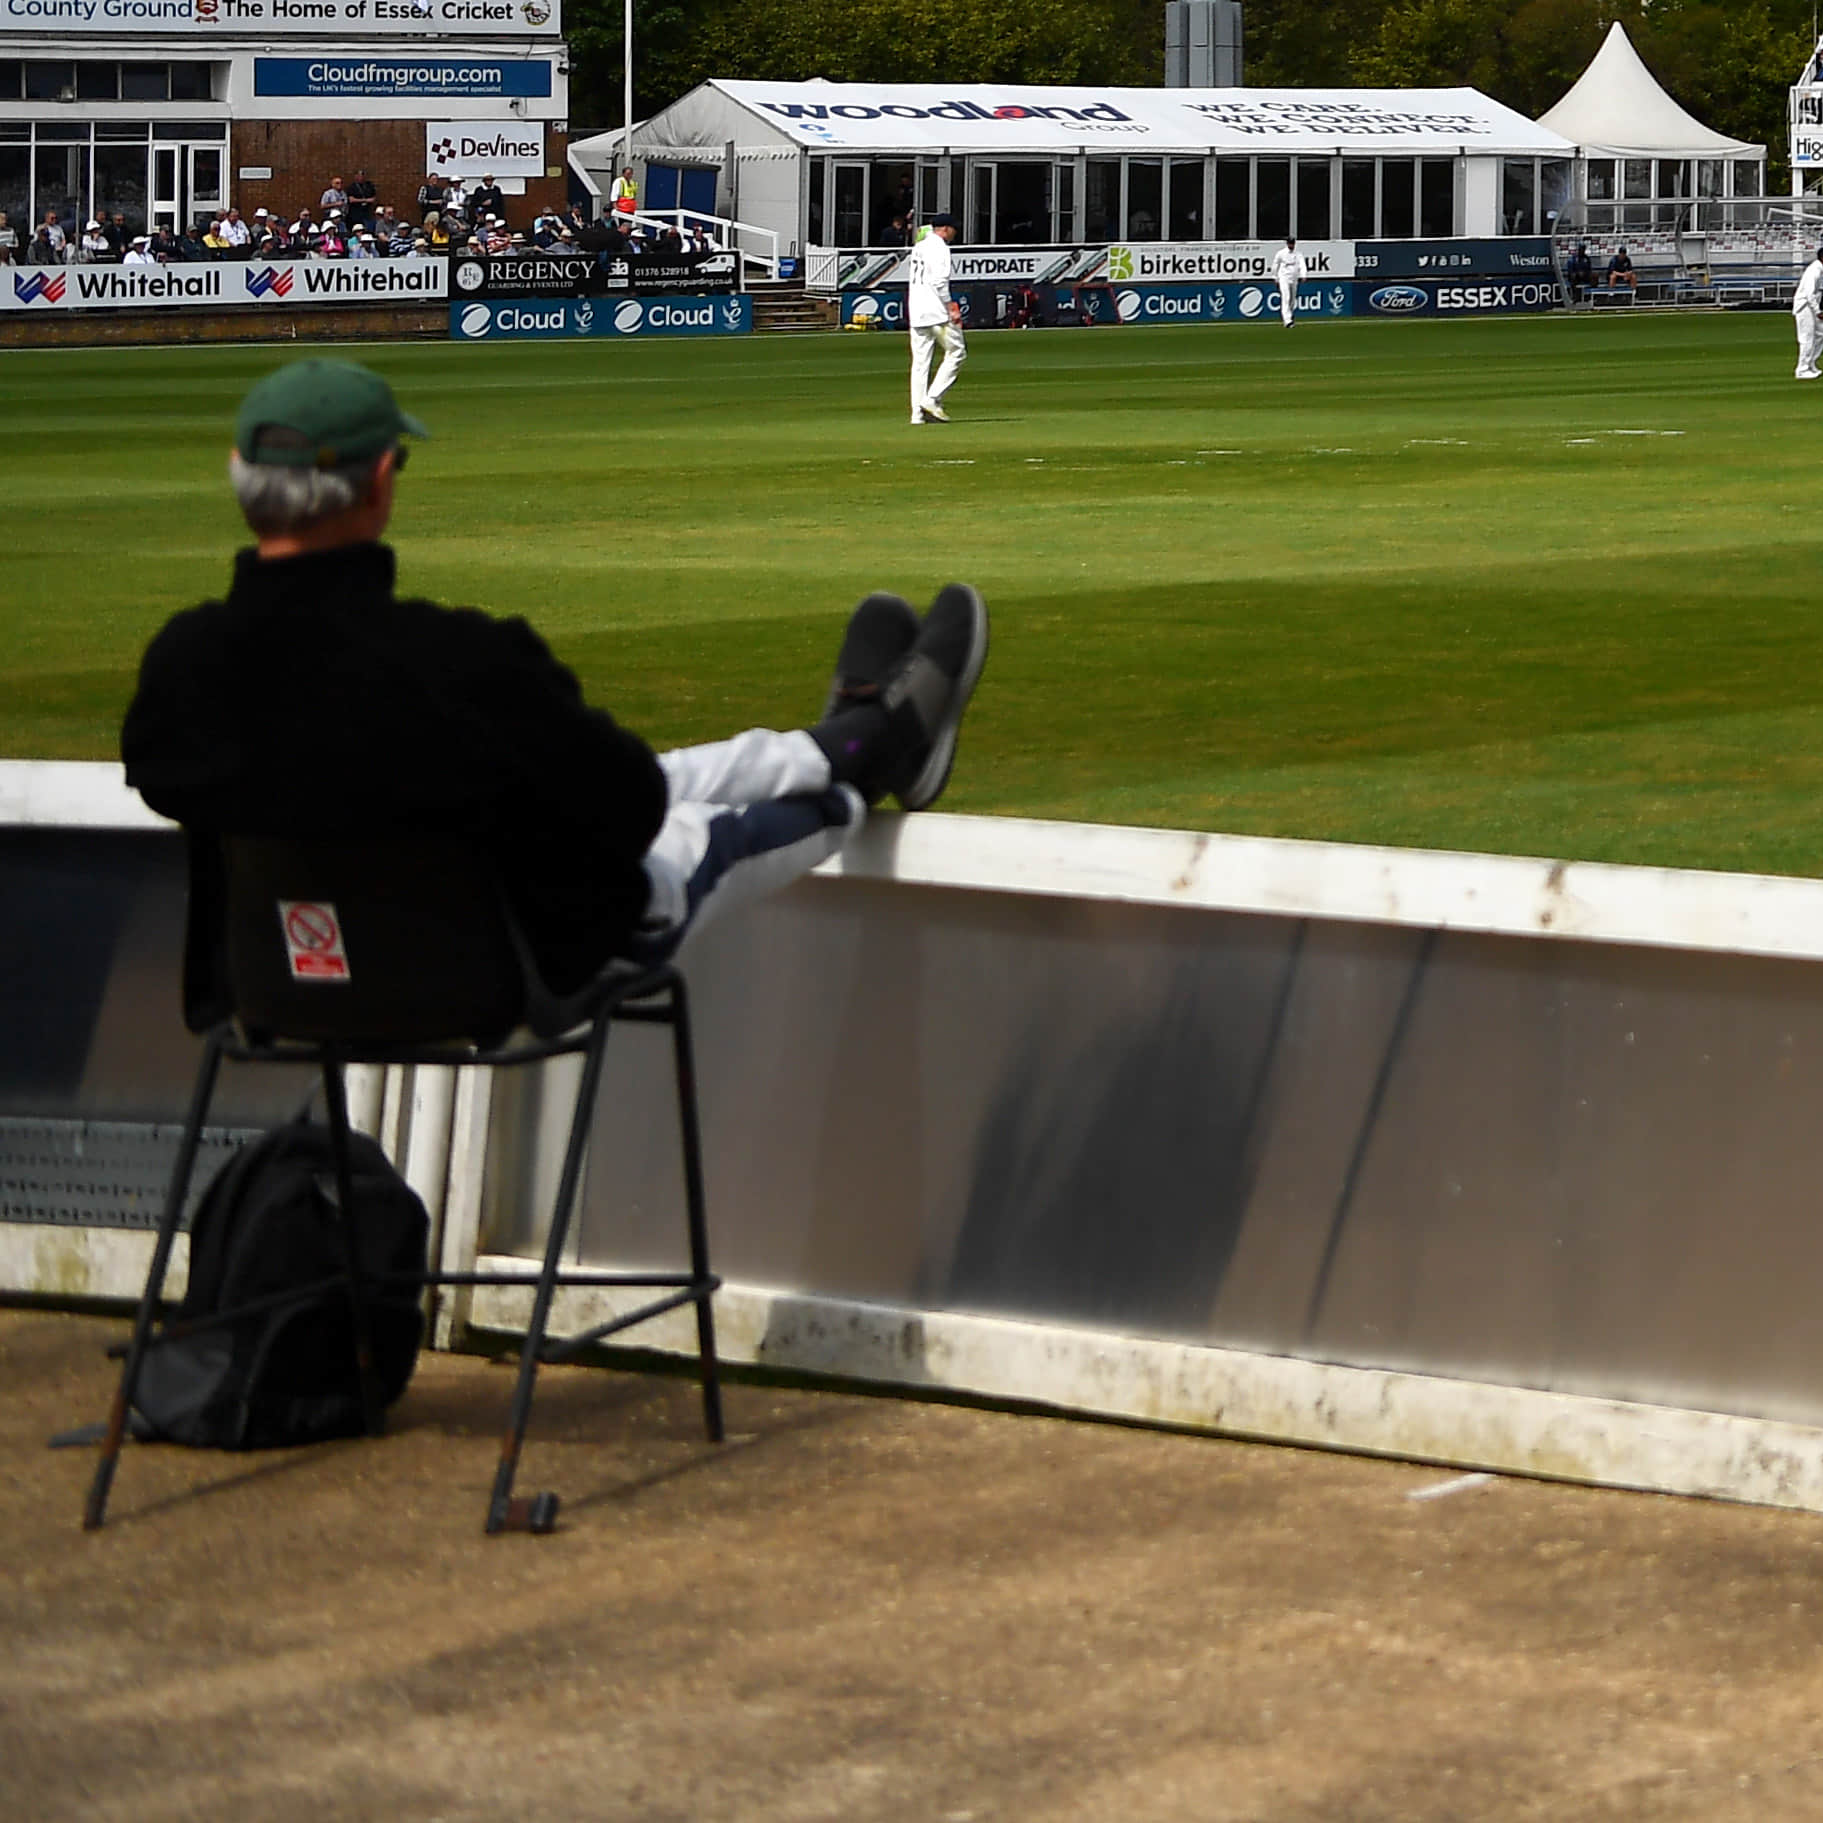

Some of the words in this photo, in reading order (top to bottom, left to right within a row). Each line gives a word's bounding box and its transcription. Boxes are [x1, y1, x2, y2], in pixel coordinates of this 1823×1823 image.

[223, 0, 263, 18] The
[273, 0, 336, 19] Home
[345, 0, 366, 19] of
[375, 1, 433, 20] Essex
[442, 1, 514, 20] Cricket
[308, 64, 502, 85] Cloudfmgroup.com
[308, 84, 322, 92] The
[365, 85, 393, 94] growing
[424, 86, 469, 94] management
[754, 100, 1135, 120] woodland
[1181, 103, 1255, 113] WE
[1260, 102, 1383, 113] CARE.
[1060, 121, 1151, 135] Group
[1204, 114, 1277, 124] WE
[1281, 113, 1490, 124] CONNECT.
[1224, 125, 1301, 134] WE
[1307, 125, 1493, 134] DELIVER.
[460, 134, 540, 157] DeVines
[1355, 256, 1379, 267] 333
[1510, 254, 1550, 266] Weston
[303, 265, 439, 293] Whitehall
[489, 261, 596, 280] REGENCY
[634, 267, 660, 276] 01376
[77, 270, 221, 299] Whitehall
[487, 281, 525, 289] GUARDING
[1144, 293, 1202, 315] Cloud
[1266, 291, 1322, 312] Cud
[1379, 289, 1418, 308] Ford
[1437, 286, 1508, 308] ESSEX
[1511, 283, 1564, 305] FORD
[496, 308, 565, 331] Cloud
[648, 304, 714, 327] Cloud
